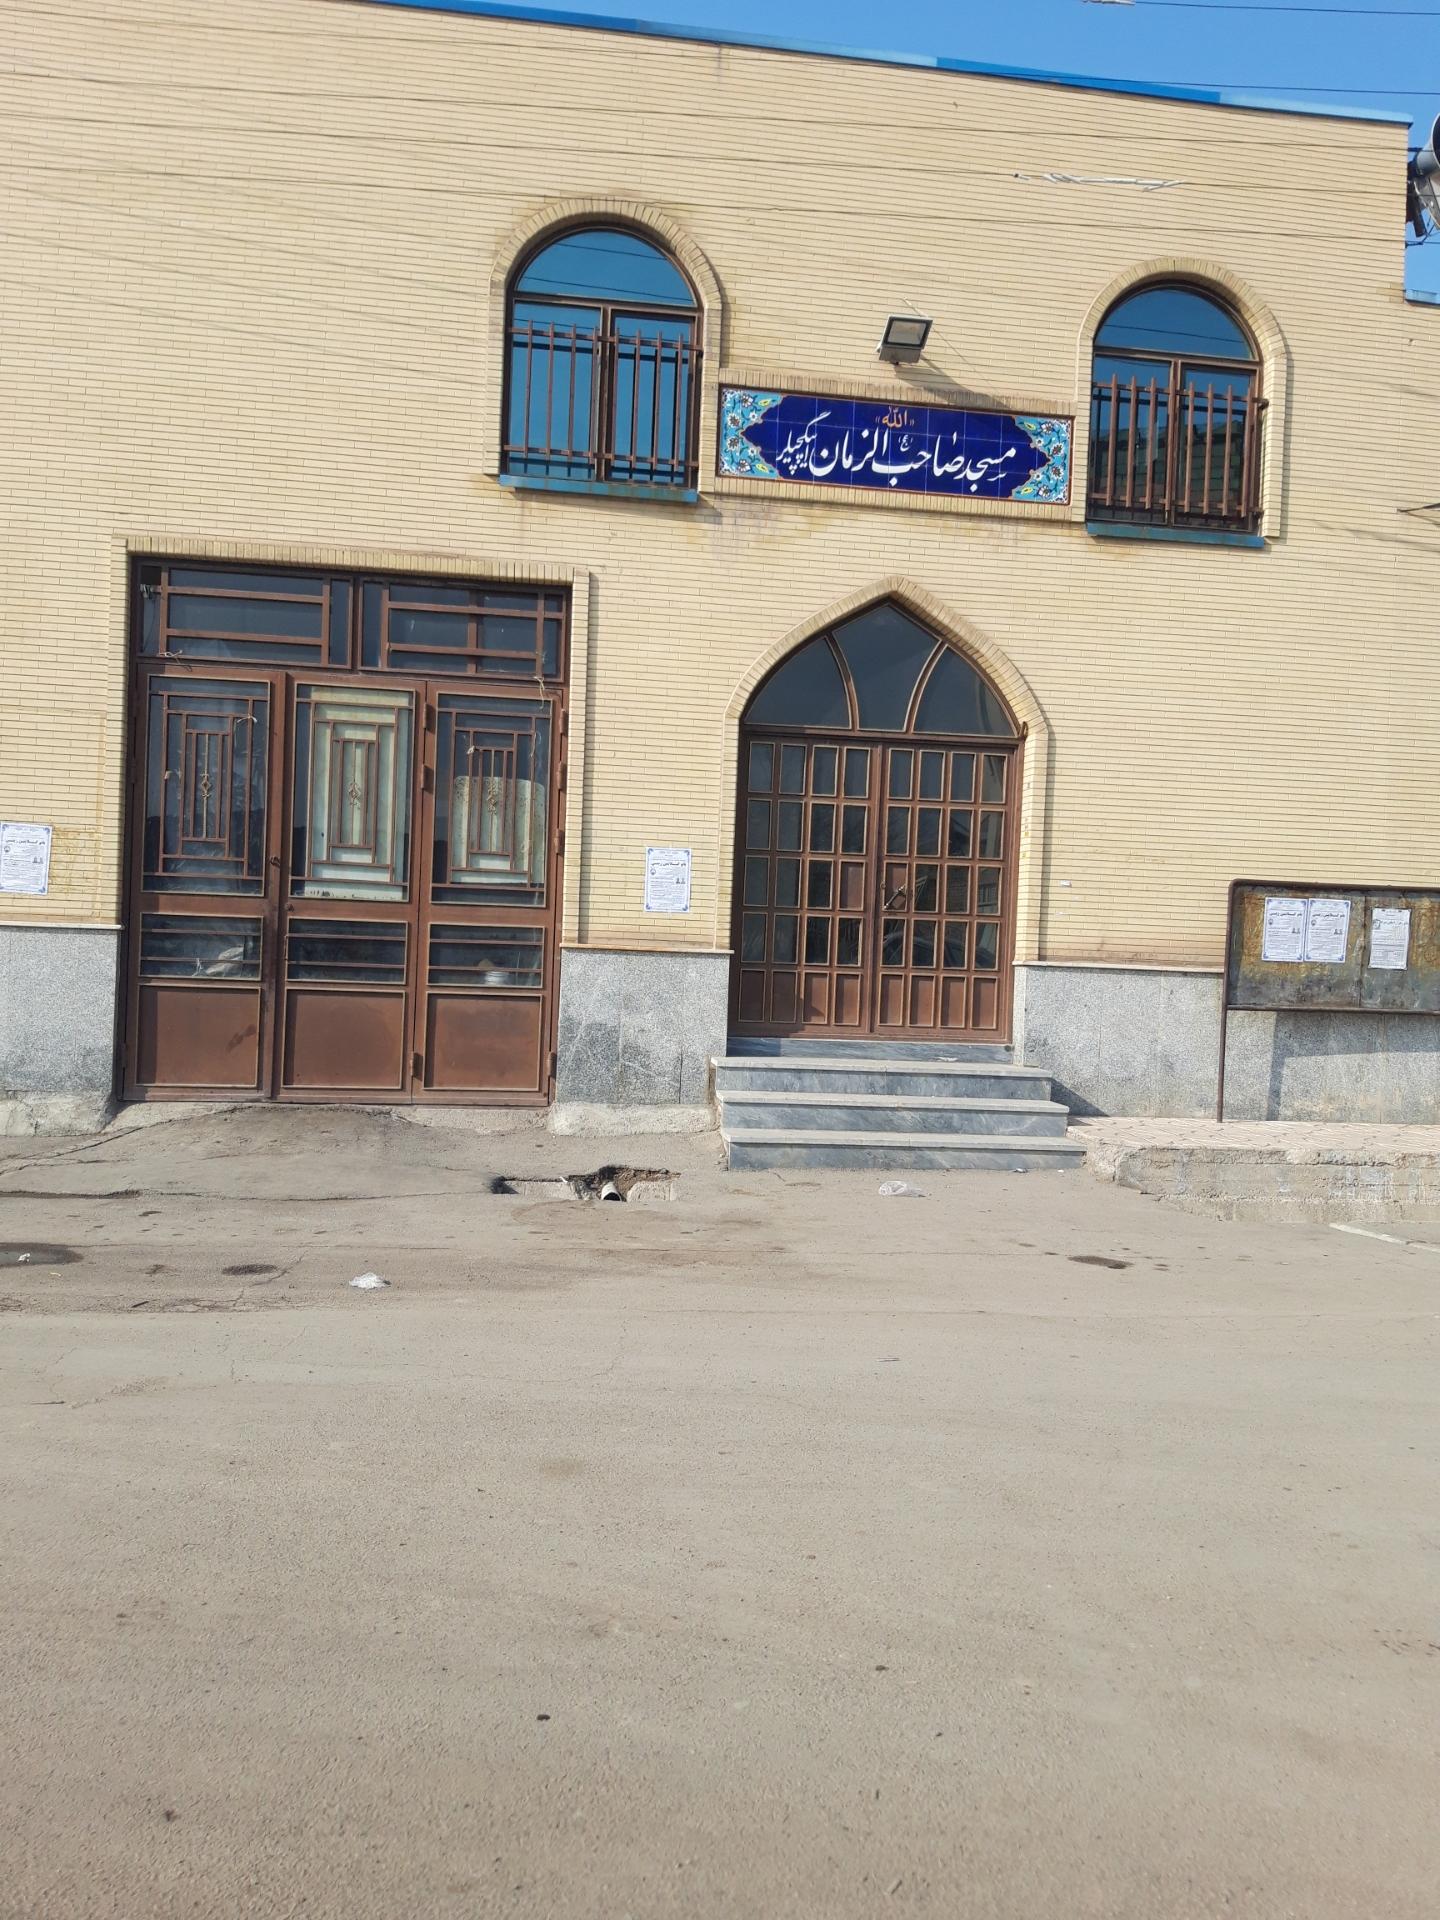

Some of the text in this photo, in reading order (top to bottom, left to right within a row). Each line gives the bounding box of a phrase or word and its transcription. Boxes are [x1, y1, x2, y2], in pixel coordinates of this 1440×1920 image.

[808, 426, 890, 477] الزمان
[871, 431, 966, 487] صاحب
[953, 446, 1017, 493] مسجد
